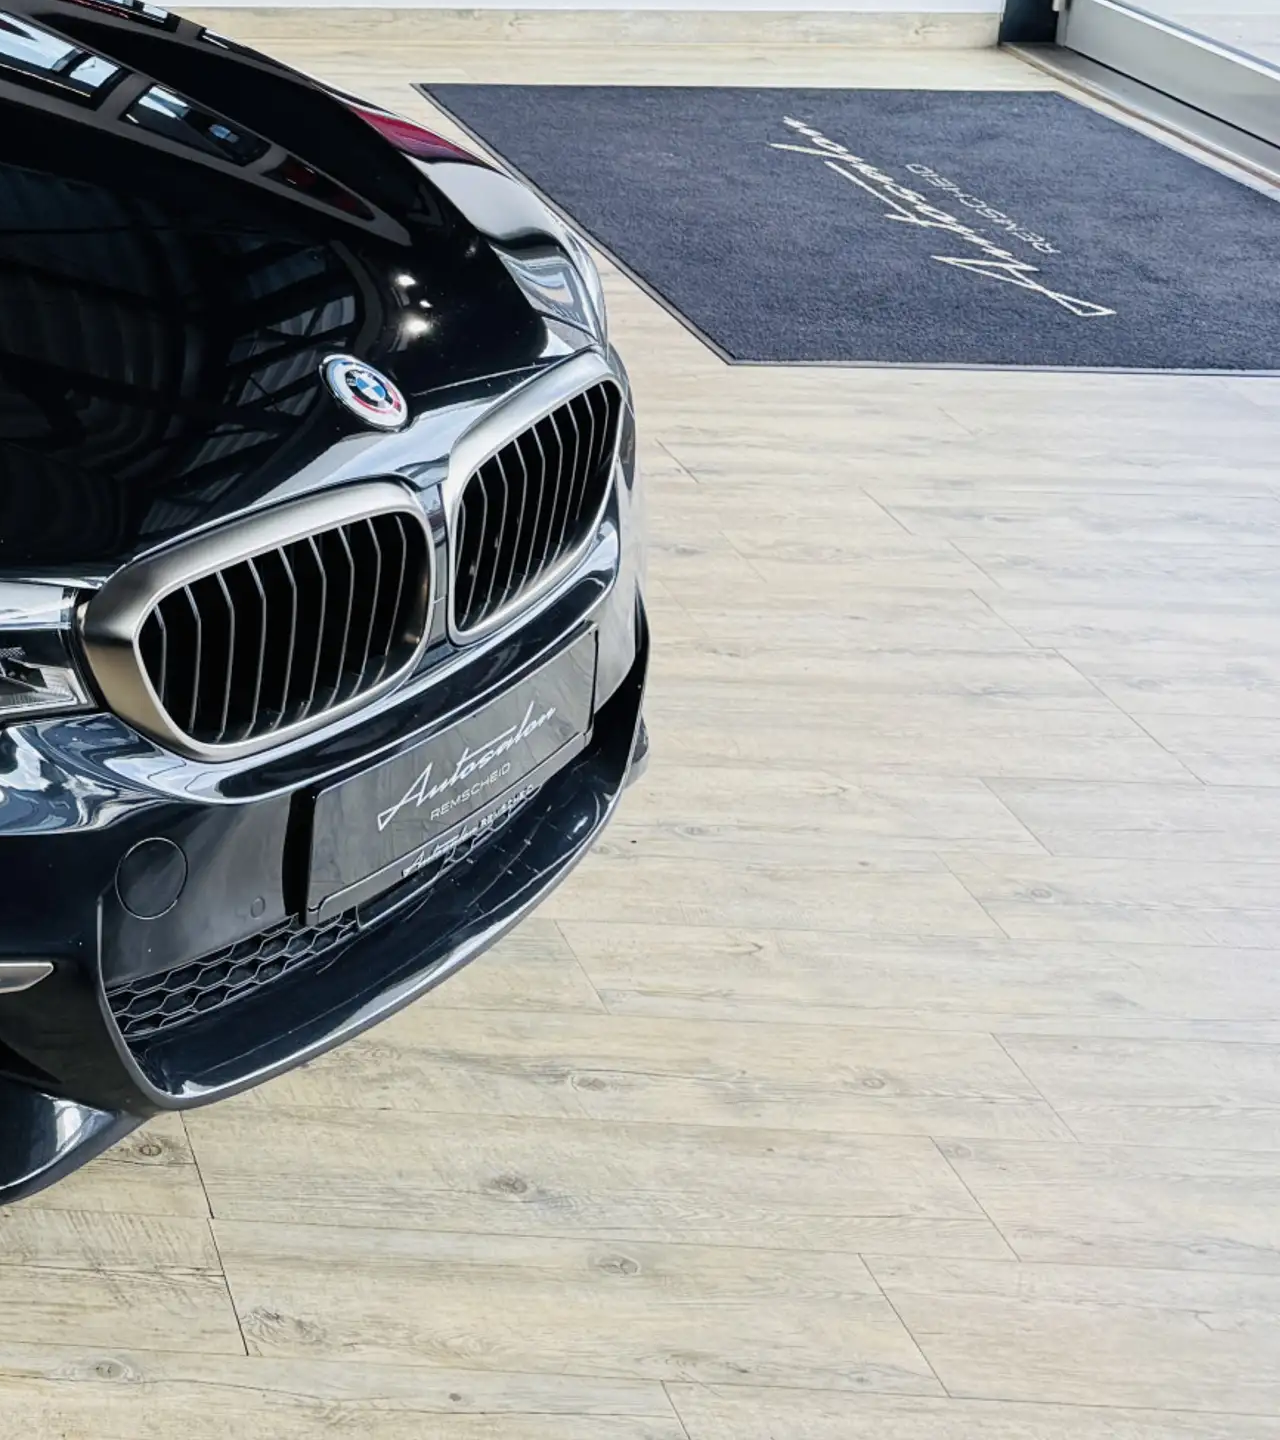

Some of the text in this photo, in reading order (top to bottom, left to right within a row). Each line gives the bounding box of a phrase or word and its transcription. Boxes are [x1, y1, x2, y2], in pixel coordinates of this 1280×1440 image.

[770, 116, 1117, 317] Autosalon
[905, 162, 1062, 255] REMSCHEID
[377, 700, 557, 832] Autosalon
[430, 762, 511, 821] REMSCHEID
